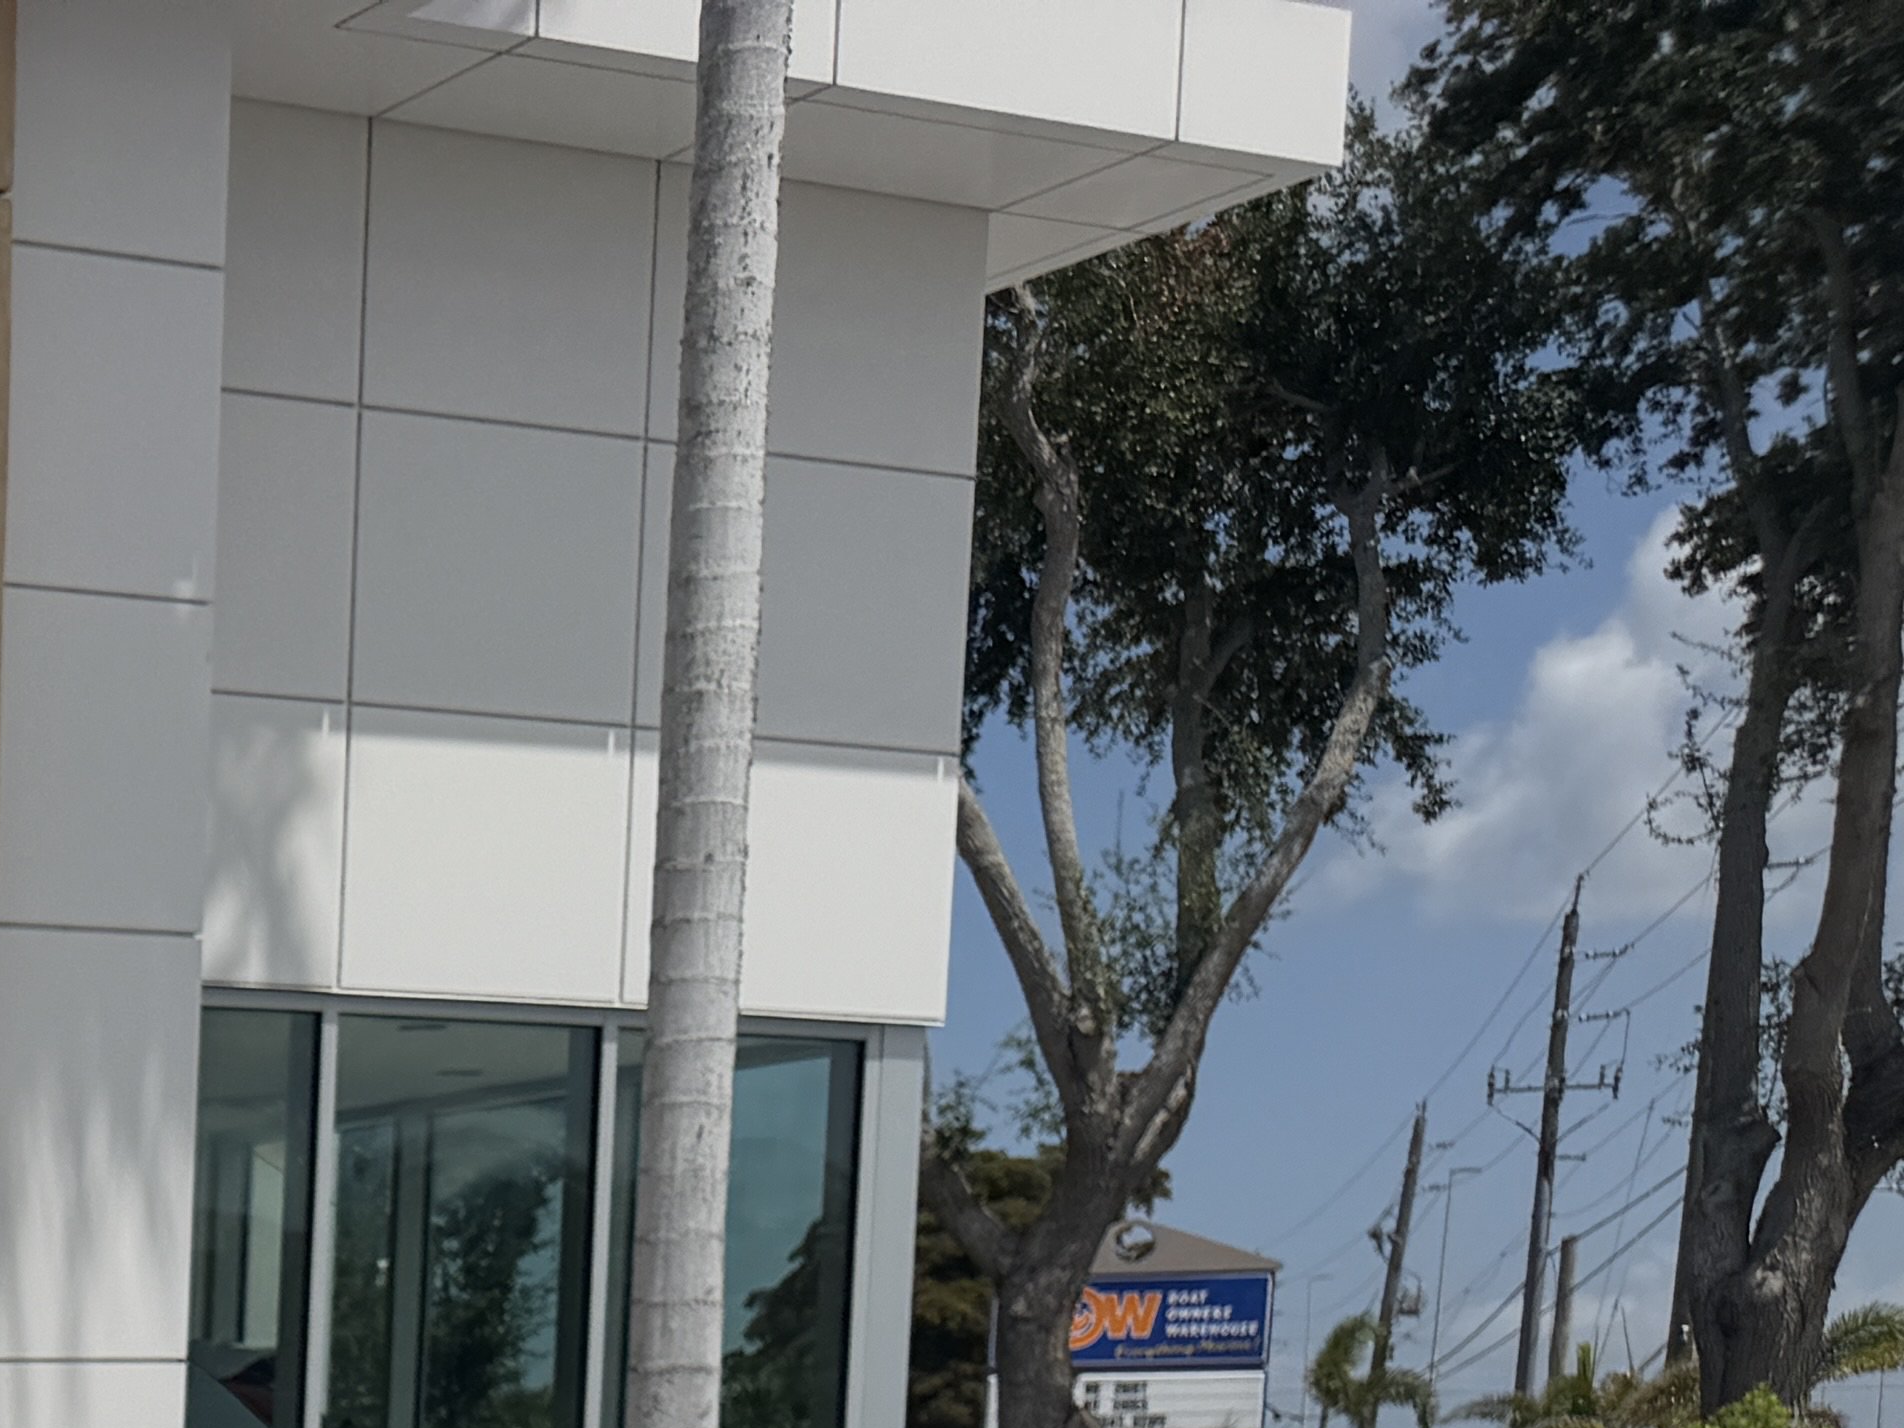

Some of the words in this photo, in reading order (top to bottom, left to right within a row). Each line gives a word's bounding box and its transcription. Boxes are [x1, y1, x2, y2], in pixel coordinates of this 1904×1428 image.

[1166, 1289, 1209, 1305] BOAT
[1068, 1285, 1163, 1350] OW
[1165, 1305, 1233, 1321] OWNERS
[1165, 1321, 1259, 1338] WAREHOUSE
